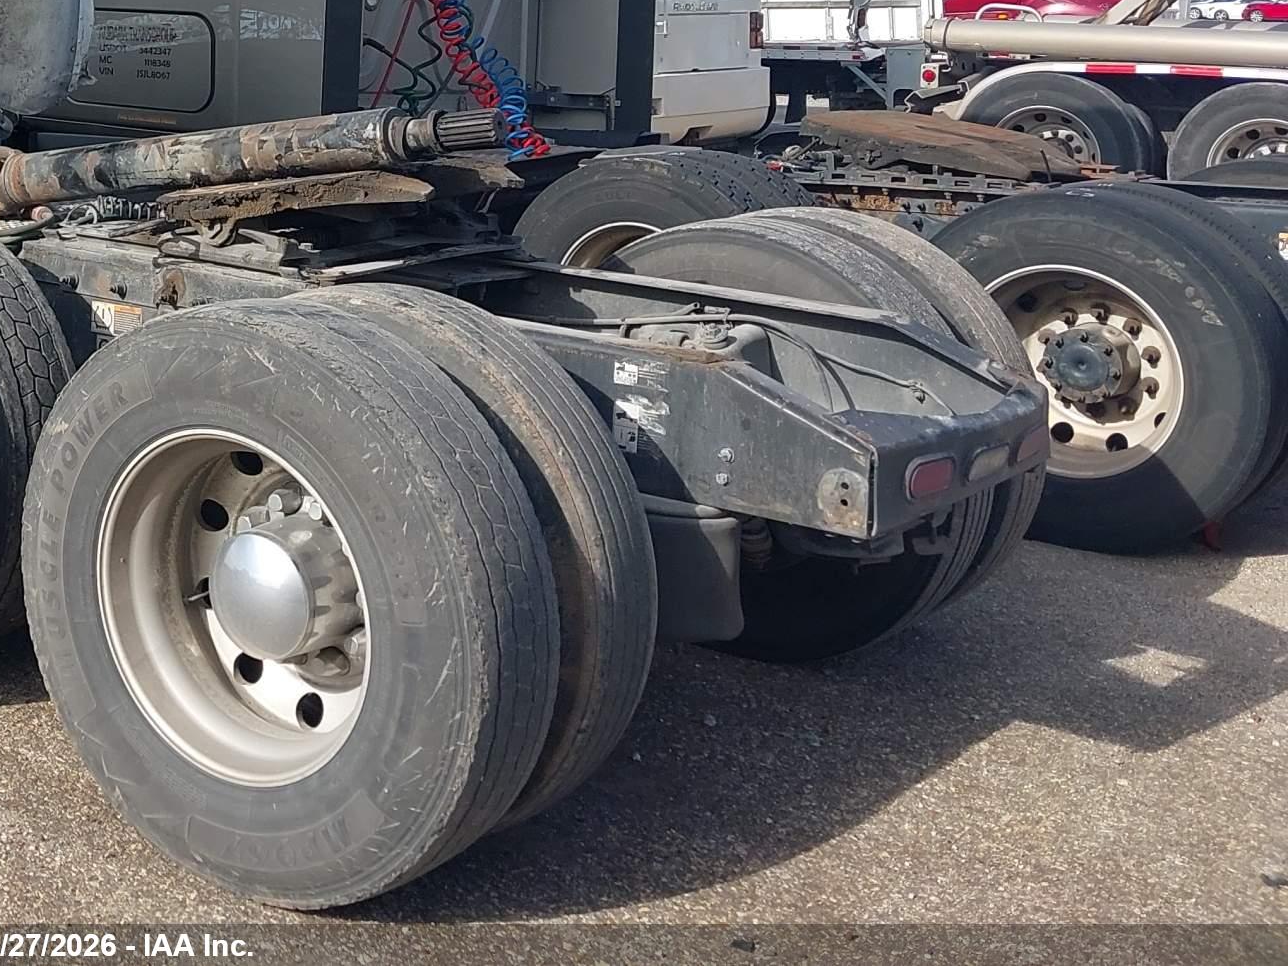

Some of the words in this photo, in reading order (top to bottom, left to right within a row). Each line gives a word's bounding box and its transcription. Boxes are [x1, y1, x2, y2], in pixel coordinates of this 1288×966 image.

[99, 56, 113, 64] MC
[99, 67, 114, 76] VIN
[50, 380, 128, 498] POWER
